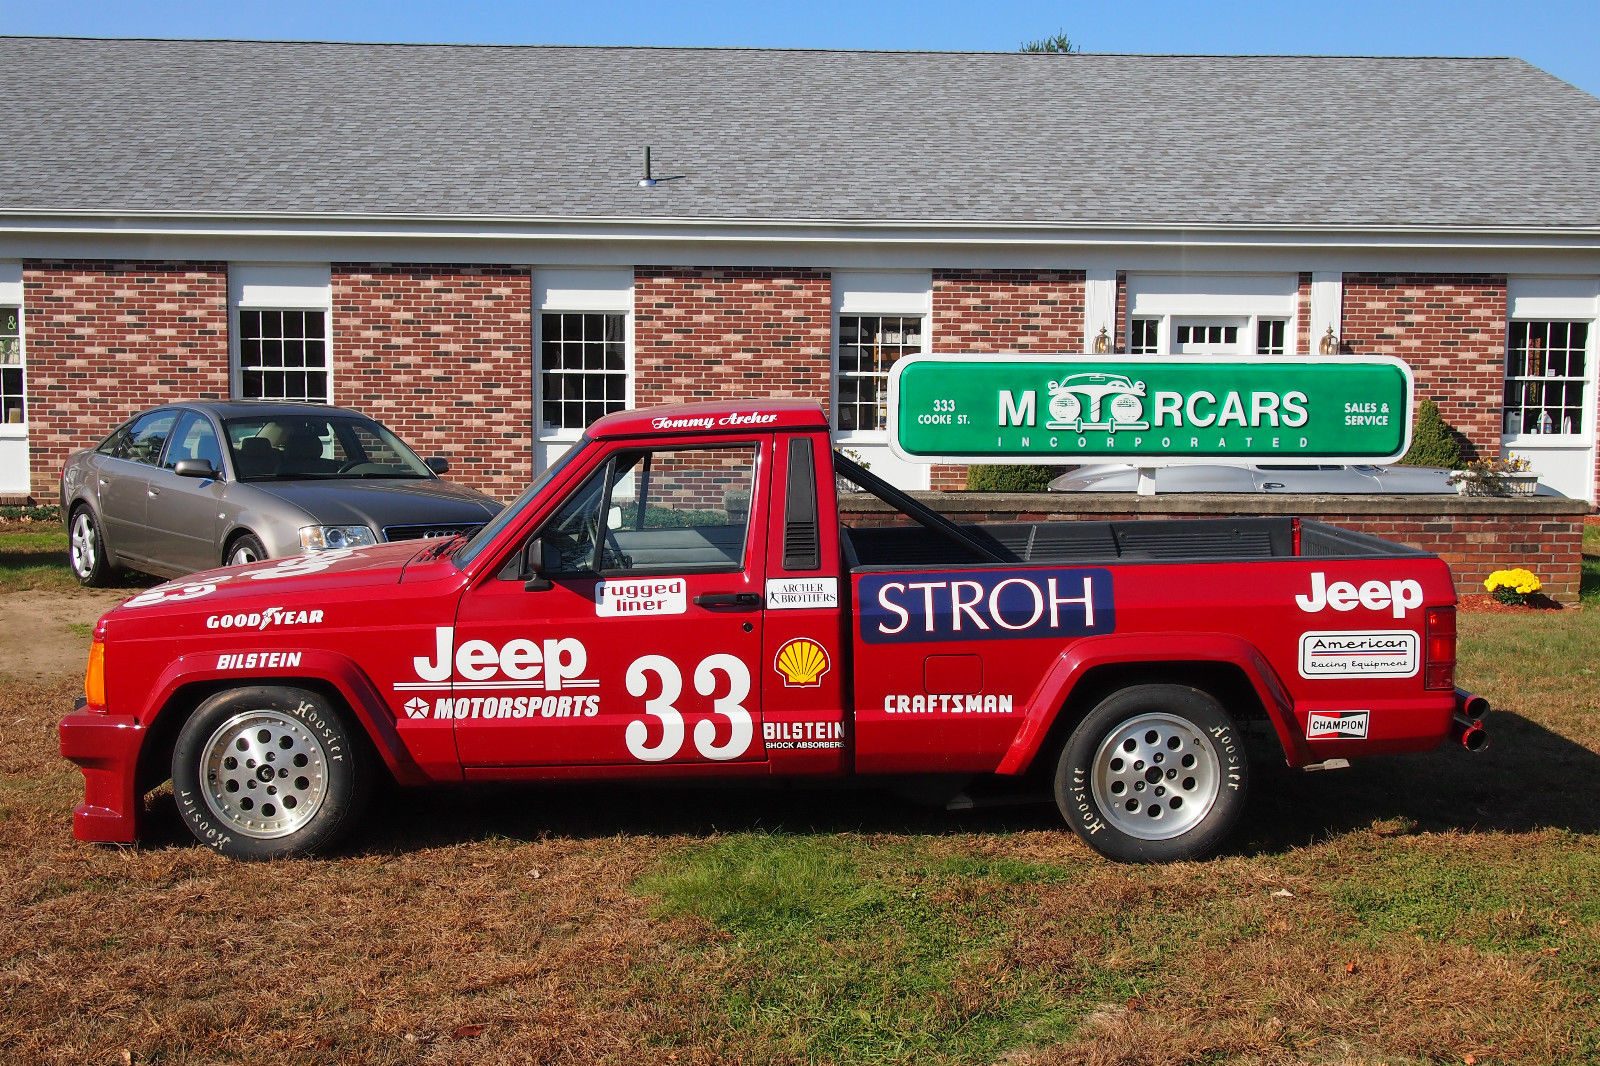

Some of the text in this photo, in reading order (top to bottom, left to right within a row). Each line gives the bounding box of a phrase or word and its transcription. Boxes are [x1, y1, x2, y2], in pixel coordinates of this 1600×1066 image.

[933, 400, 956, 412] 333
[998, 386, 1309, 430] MOTORCARS
[1344, 403, 1390, 413] SALES &
[652, 412, 778, 429] Tommy Archer
[918, 414, 970, 425] COOKE ST.
[1344, 416, 1388, 426] SERVICE
[997, 437, 1308, 448] INCORPORATED
[600, 582, 681, 598] rugged
[781, 584, 824, 593] ARCHER
[1295, 572, 1424, 619] Jeep
[616, 599, 667, 611] liner
[781, 594, 836, 603] BROTHERS
[878, 577, 1095, 634] STROH
[206, 608, 324, 629] GOODYEAR
[1313, 638, 1407, 649] American
[216, 652, 302, 670] BILSTEIN
[413, 627, 587, 691] Jeep
[1311, 661, 1407, 669] Racing Equipment
[434, 695, 600, 719] MOTORSPORTS
[625, 653, 753, 762] 33
[884, 694, 1013, 713] CRAFTSMAN
[293, 701, 342, 762] Hoosier
[763, 722, 845, 740] BILSTEIN
[1312, 720, 1364, 730] CHAMPION
[796, 741, 845, 749] ABSORBERS
[1209, 726, 1241, 791] Hoosier
[1070, 768, 1106, 835] Hoosier
[180, 790, 231, 850] Hoosier
